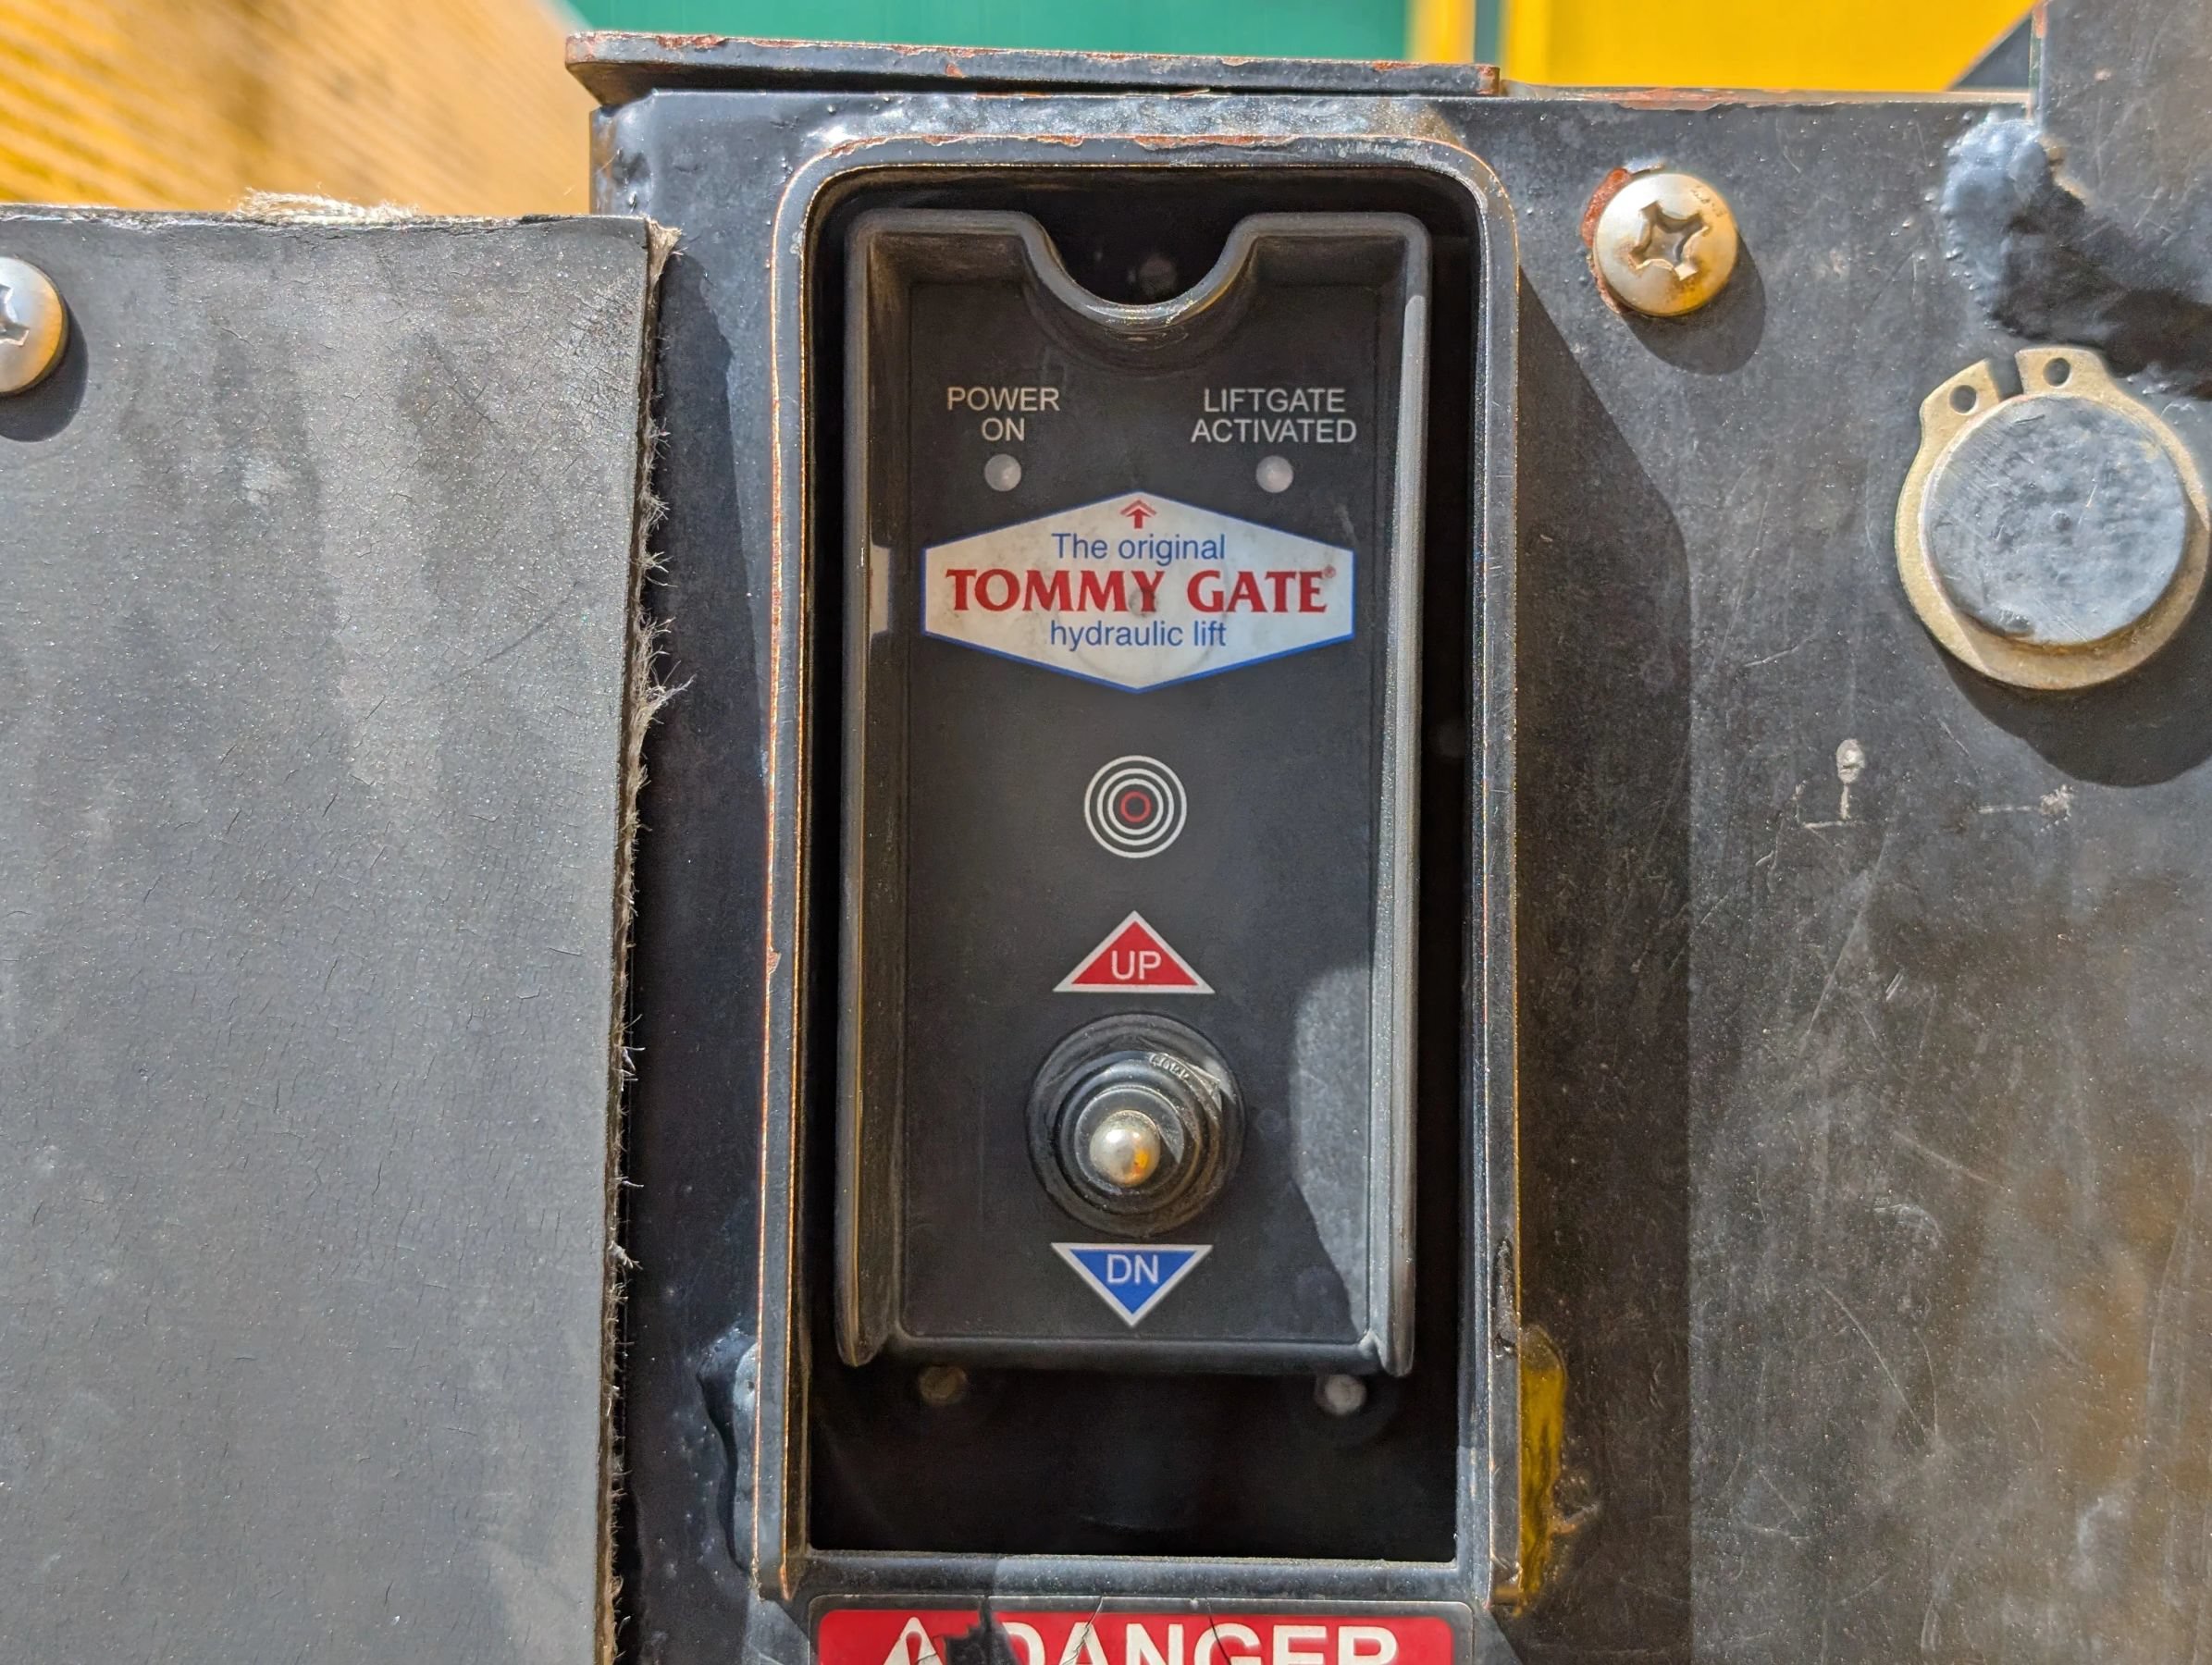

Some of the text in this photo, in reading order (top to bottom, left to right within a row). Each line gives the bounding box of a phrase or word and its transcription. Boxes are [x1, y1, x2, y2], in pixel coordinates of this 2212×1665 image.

[945, 387, 1060, 413] POWER
[1203, 388, 1346, 413] LIFTGATE
[981, 416, 1025, 442] ON
[1191, 418, 1357, 444] ACTIVATED
[1051, 533, 1226, 567] The original
[945, 568, 1166, 612] TOMMY
[1050, 621, 1227, 652] hydraulic lift
[1110, 950, 1162, 980] UP
[1106, 1253, 1159, 1284] DN
